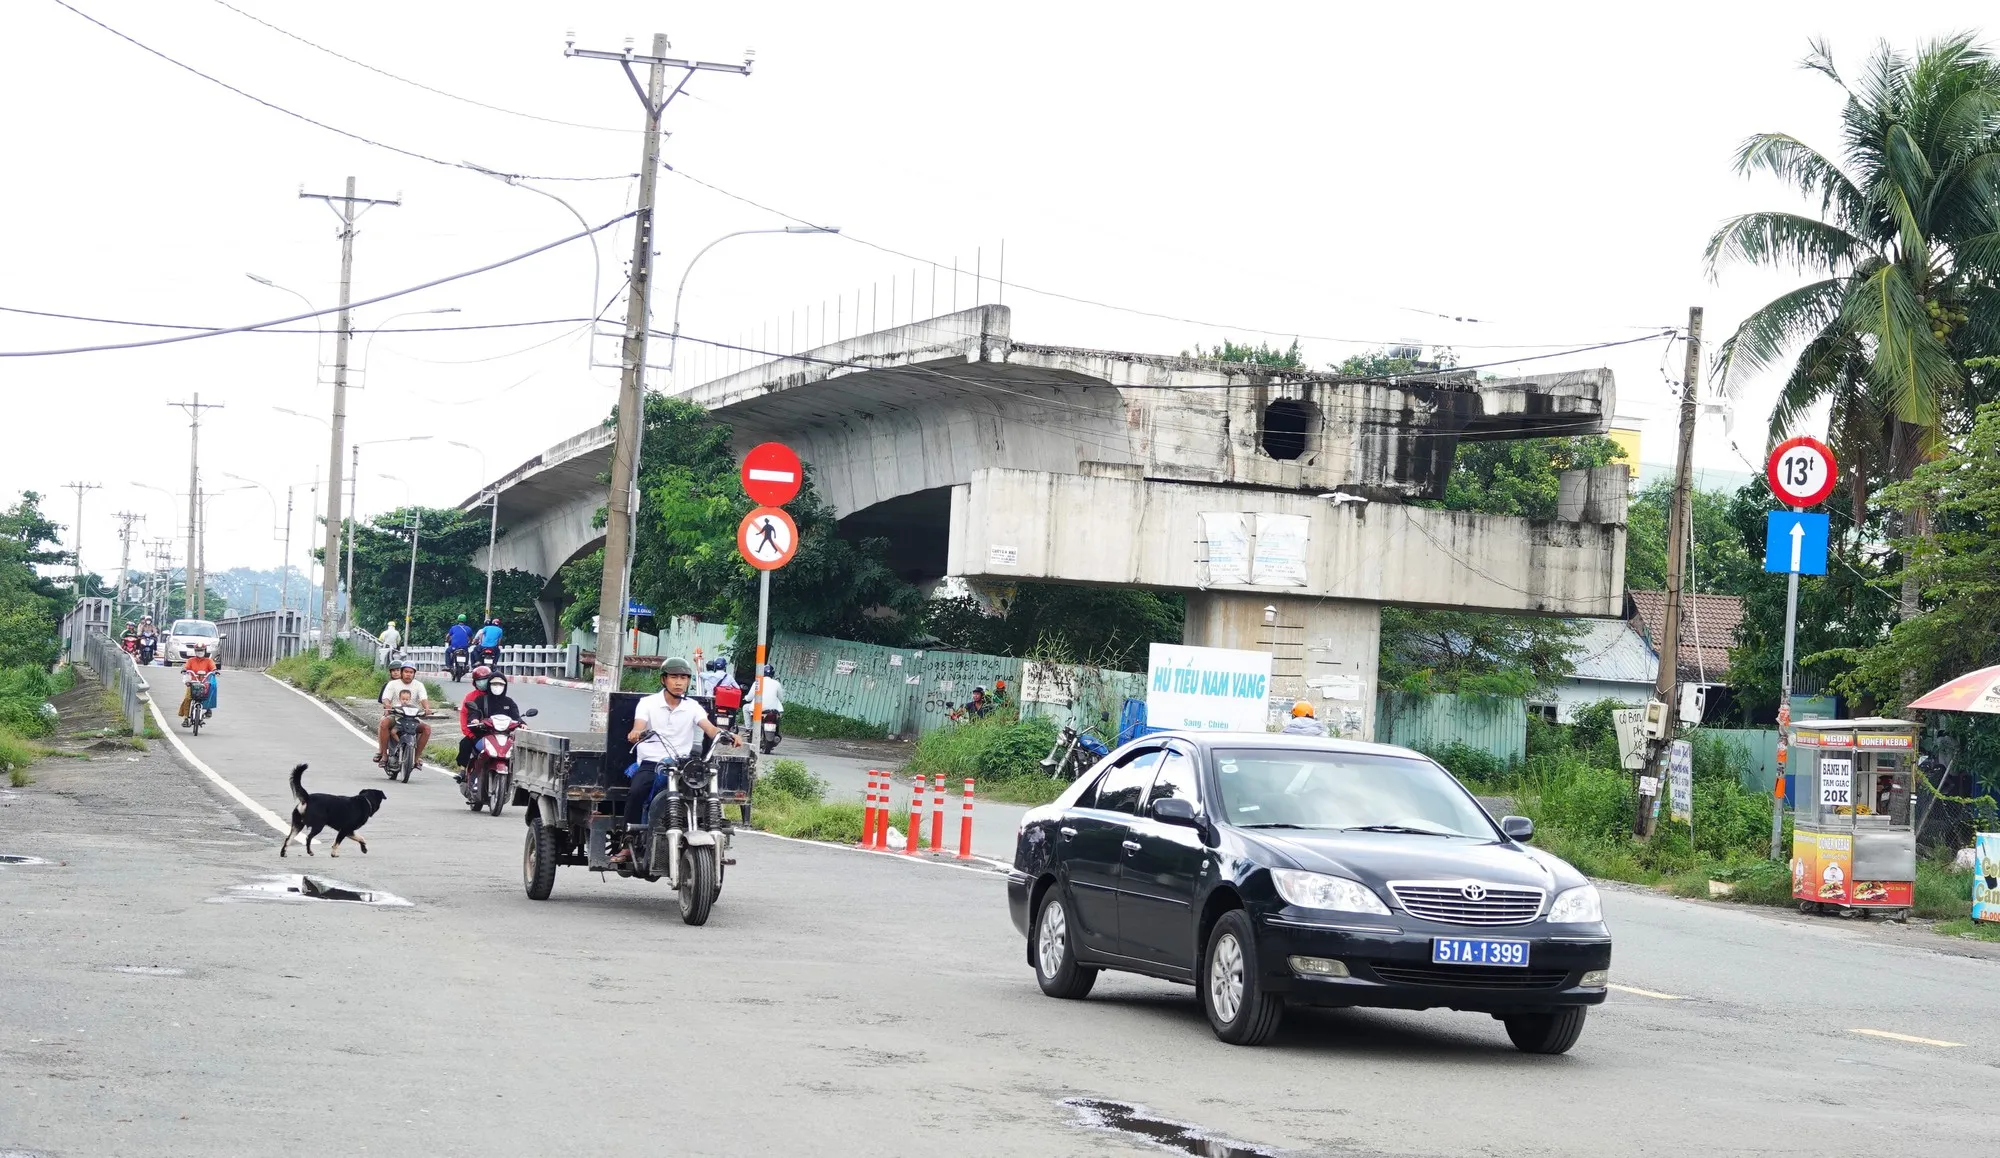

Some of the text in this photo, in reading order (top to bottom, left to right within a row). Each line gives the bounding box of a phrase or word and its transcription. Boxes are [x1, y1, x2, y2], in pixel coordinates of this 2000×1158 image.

[1153, 657, 1266, 700] HỦ TIẾU NAM VANG
[1823, 735, 1850, 743] NGON
[1860, 737, 1908, 747] DONER KEBAB
[1822, 760, 1840, 776] BÁNH
[1823, 779, 1835, 787] TAM
[1823, 789, 1849, 803] 20K
